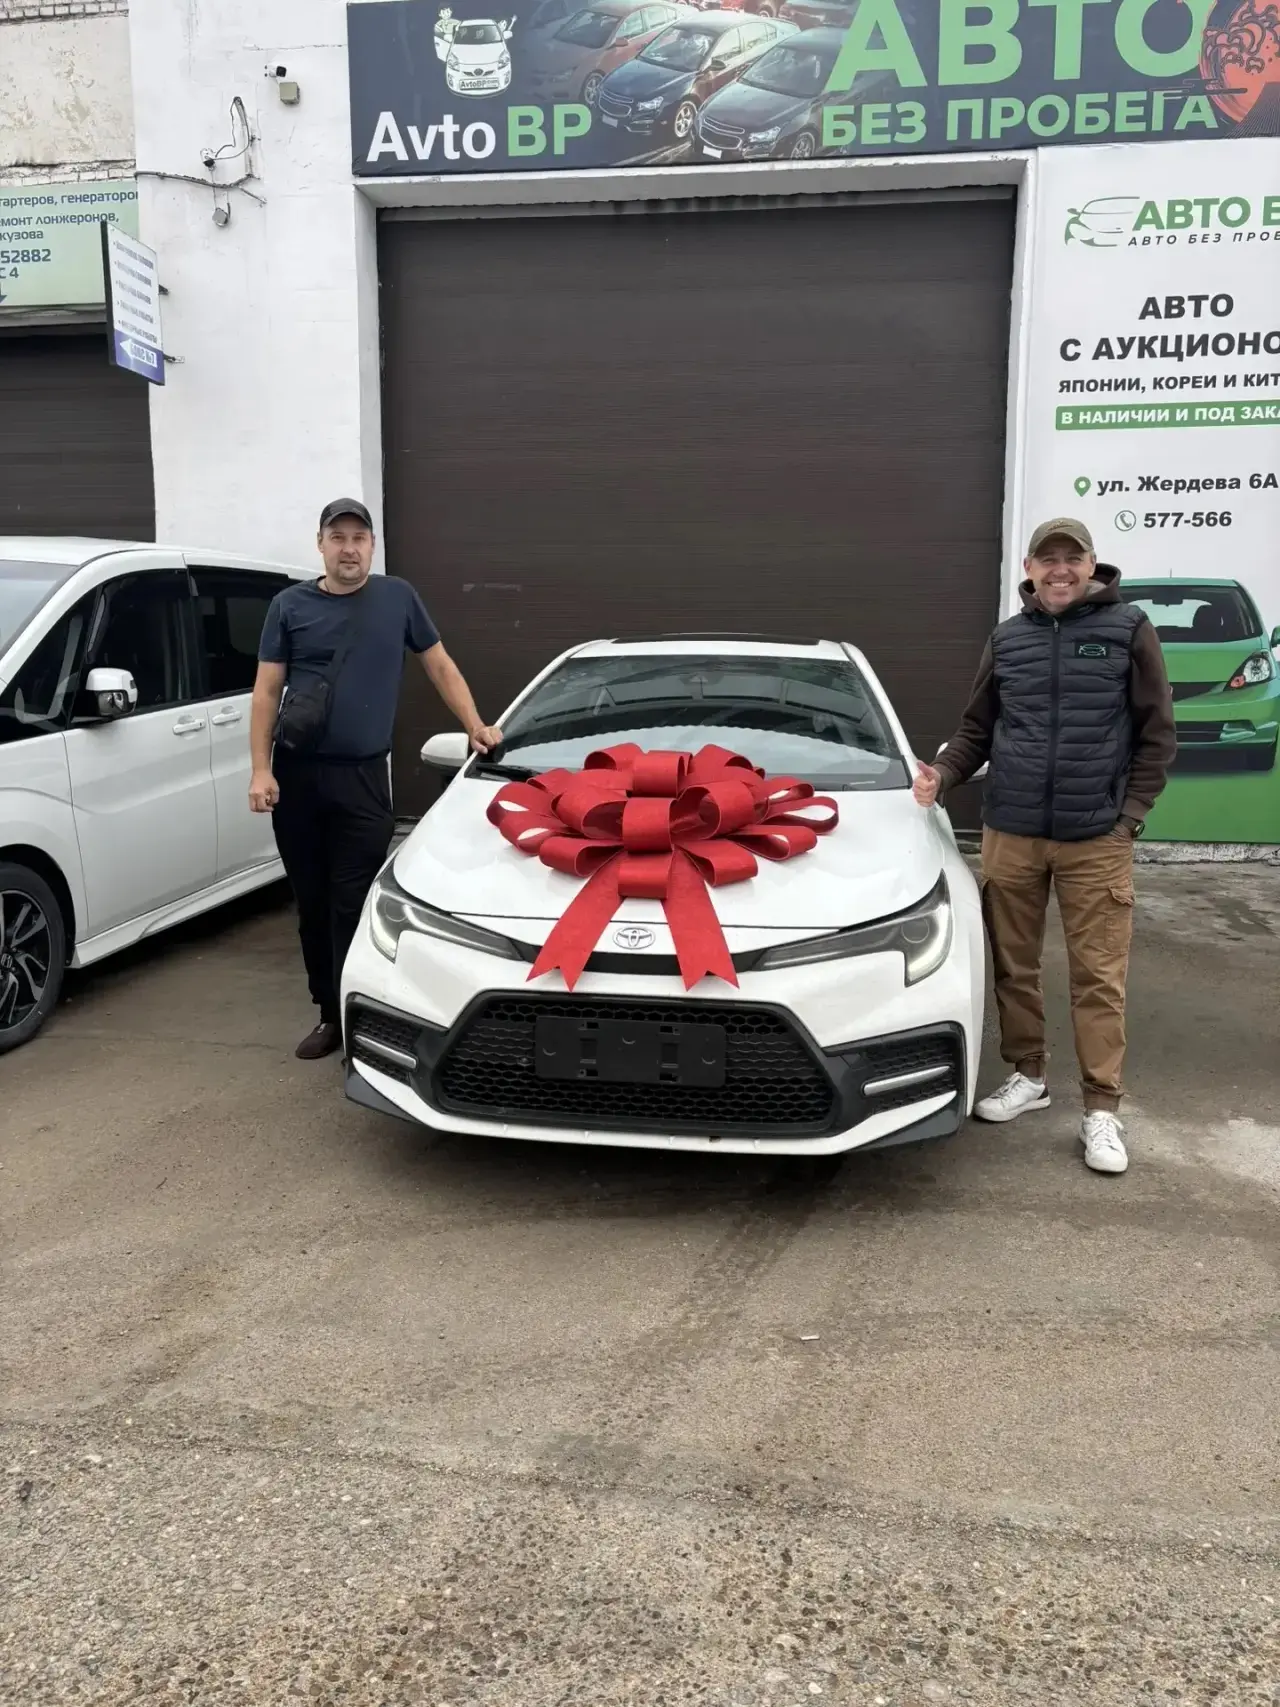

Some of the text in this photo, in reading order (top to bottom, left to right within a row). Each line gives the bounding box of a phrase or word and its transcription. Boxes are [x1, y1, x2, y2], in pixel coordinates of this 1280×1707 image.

[825, 0, 1209, 92] АВТО
[822, 90, 1219, 146] БЕЗ ПРОБЕГА
[366, 111, 497, 162] Avto
[61, 191, 138, 204] генераторо
[0, 213, 119, 227] монт лонжеронов,
[1132, 196, 1251, 231] АВТО
[1128, 235, 1177, 246] АВТО
[1188, 233, 1222, 244] БЕЗ
[9, 267, 19, 279] 4
[1138, 294, 1234, 320] АВТО
[1059, 331, 1280, 362] С АУКЦИОНО
[1058, 373, 1280, 393] ЯПОНИИ, КОРЕИ И КИТ
[1061, 406, 1280, 425] В НАЛИЧИИ И ПОД ЗАК
[1097, 473, 1279, 496] ул. Жердева 6А
[1143, 511, 1232, 528] 577-566
